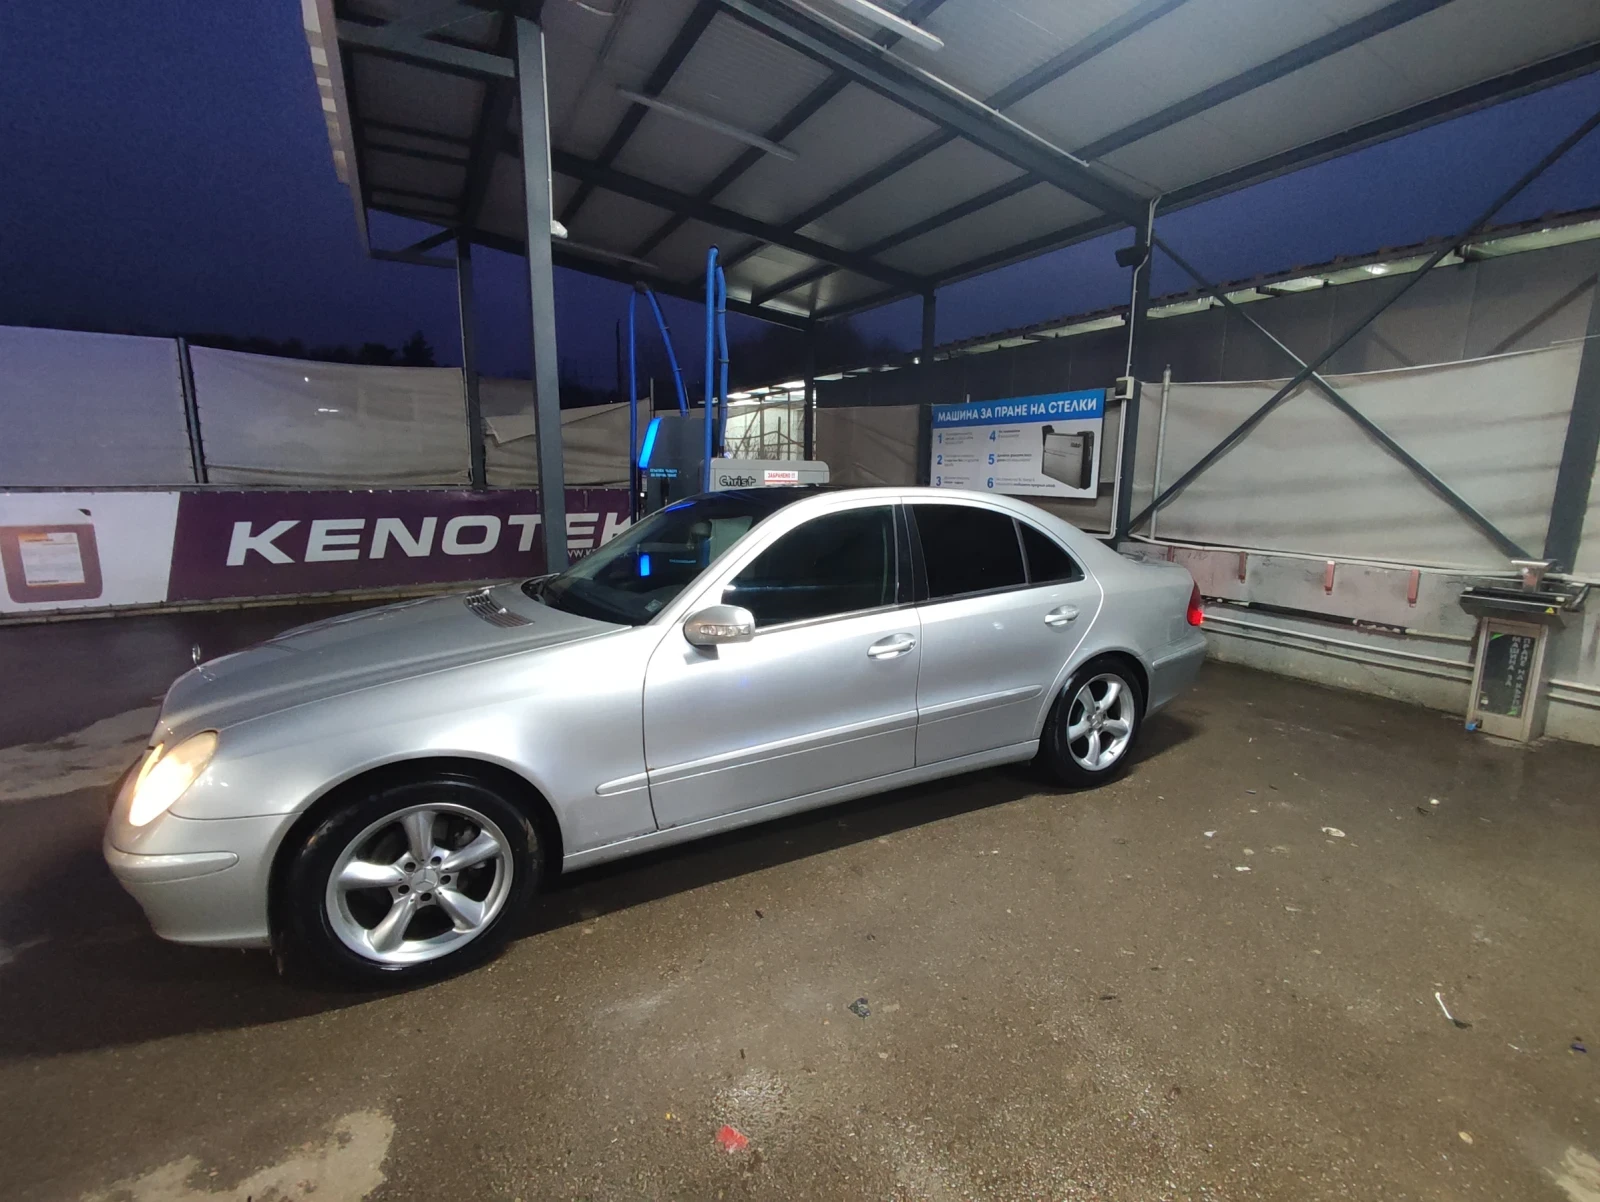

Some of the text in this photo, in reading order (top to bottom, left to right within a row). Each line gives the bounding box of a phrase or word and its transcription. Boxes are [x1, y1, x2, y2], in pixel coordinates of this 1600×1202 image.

[937, 398, 1097, 422] МАШИНА ЗА ПРАНЕ НА СТЕЛКИ
[937, 433, 943, 444] 1
[989, 431, 996, 442] 4
[936, 455, 943, 465] 2
[987, 454, 995, 465] 5
[719, 475, 756, 487] Christ
[935, 476, 942, 487] 3
[987, 478, 994, 489] 6
[226, 513, 631, 566] KENOTEK
[1520, 638, 1530, 667] ПРАНЕ
[1505, 637, 1520, 687] МАШИНА ЗА
[1516, 669, 1525, 680] НА
